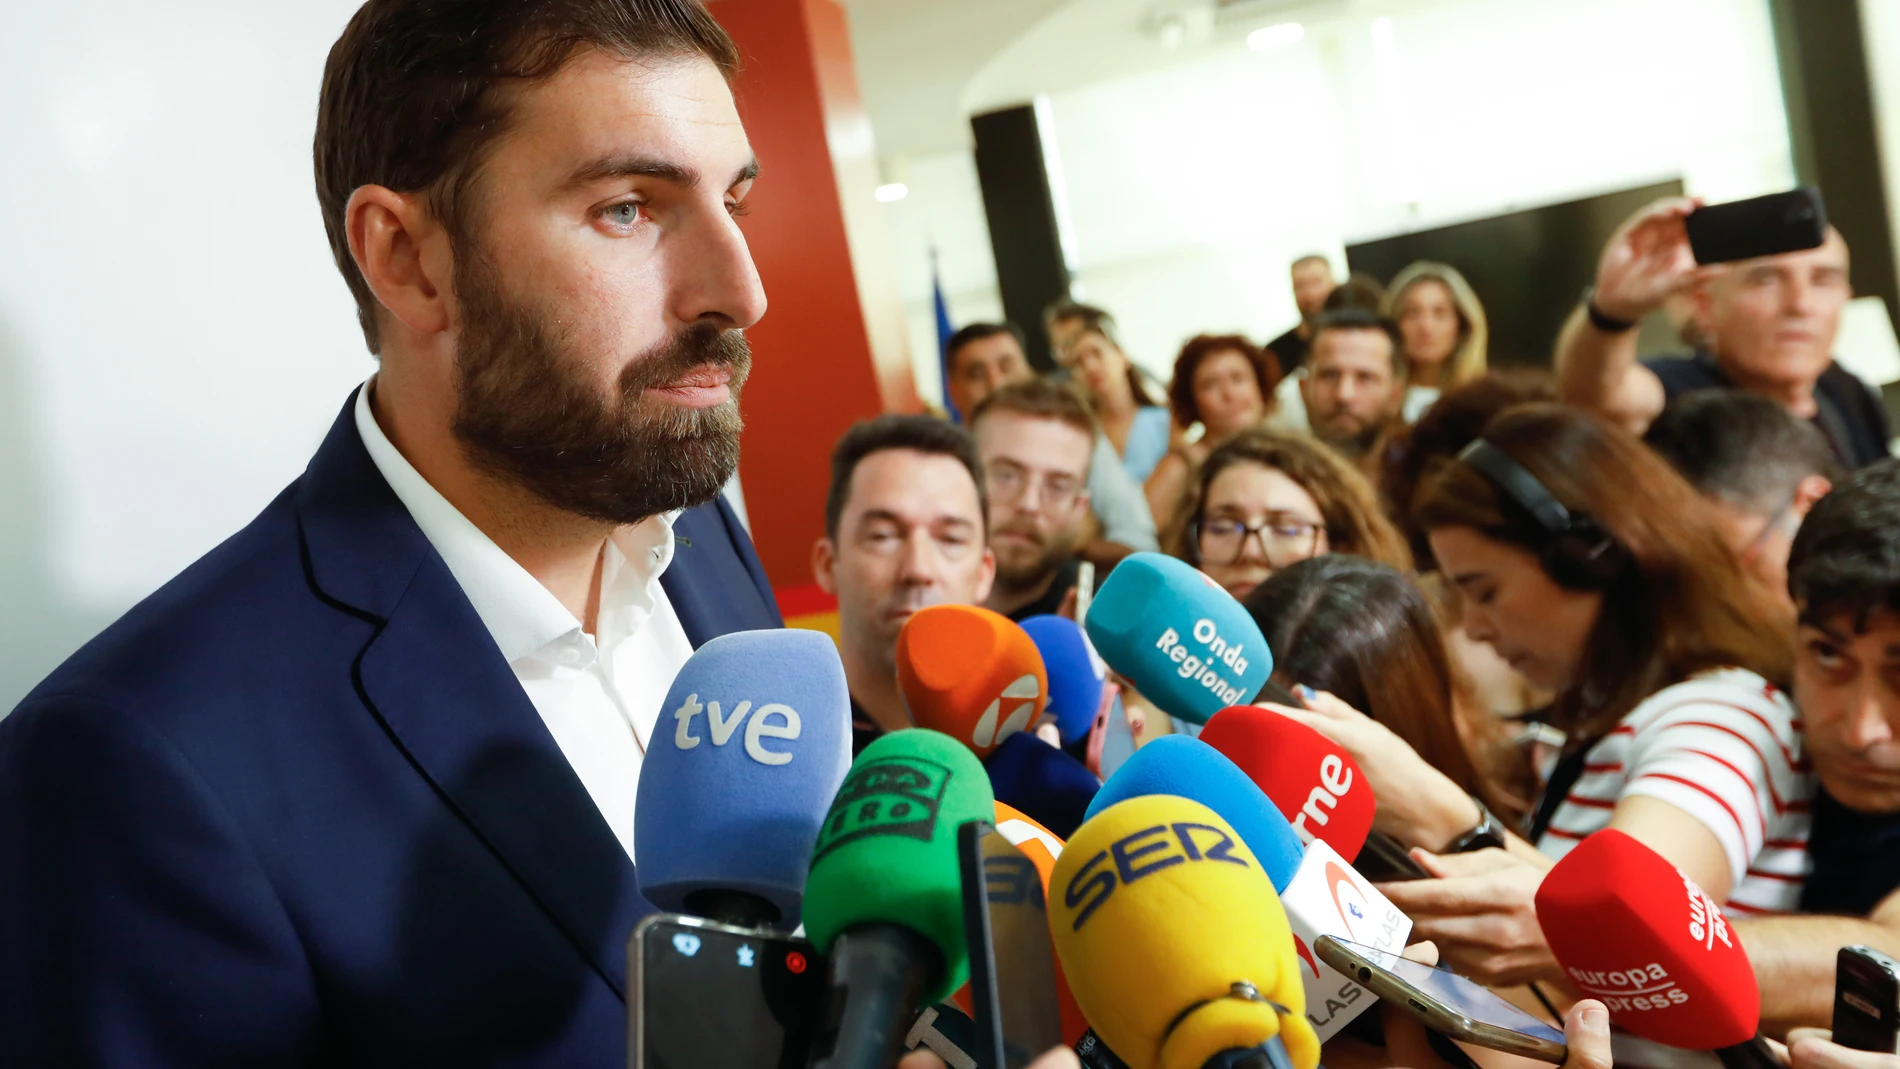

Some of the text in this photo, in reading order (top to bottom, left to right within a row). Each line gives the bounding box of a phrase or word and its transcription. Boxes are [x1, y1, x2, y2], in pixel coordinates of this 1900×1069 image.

[1155, 626, 1248, 708] Regional
[1193, 618, 1249, 677] Onda
[674, 693, 802, 766] tve
[1291, 753, 1353, 847] rne
[1065, 821, 1250, 933] SER
[1307, 980, 1363, 1028] LAS
[1568, 962, 1669, 990] europa
[1602, 987, 1690, 1014] press
[1077, 1036, 1097, 1058] AKG
